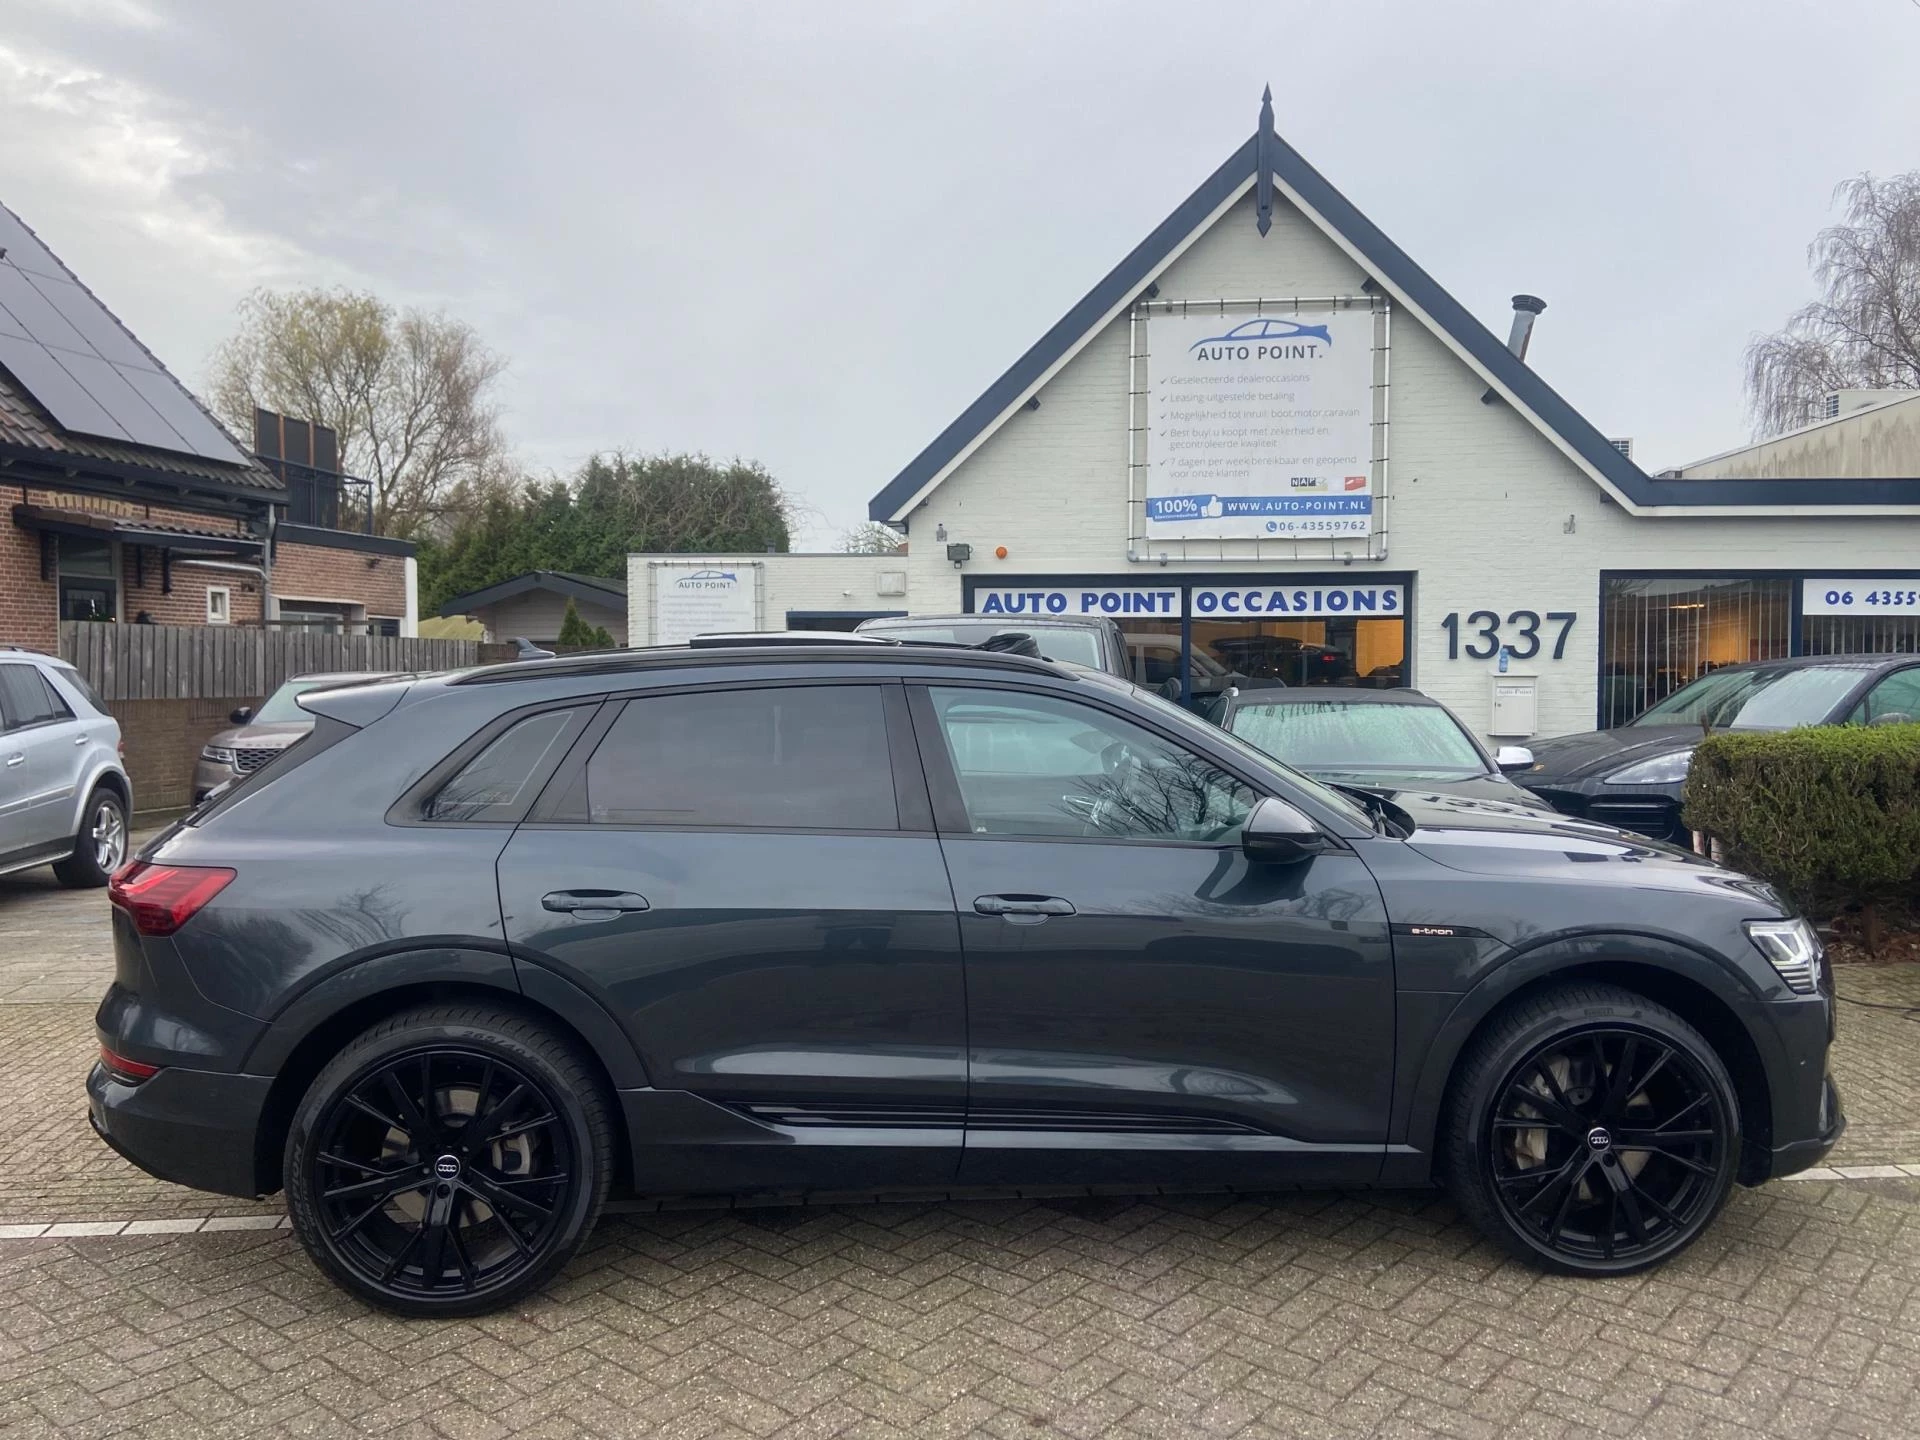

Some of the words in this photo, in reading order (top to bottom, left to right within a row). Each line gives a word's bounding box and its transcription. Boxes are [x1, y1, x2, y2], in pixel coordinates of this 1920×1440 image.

[1197, 346, 1250, 361] AUTO
[1155, 498, 1198, 514] 100%
[1227, 501, 1367, 511] WWW.AUTO-POINT.NL
[1279, 521, 1366, 531] 06-43559762
[982, 592, 1068, 614] AUTO
[1080, 591, 1176, 613] POINT
[1196, 589, 1399, 613] OCCASIONS
[1825, 590, 1854, 605] 06
[1865, 590, 1920, 606] 4355
[1440, 610, 1578, 660] 1337
[1411, 927, 1454, 935] e-tron
